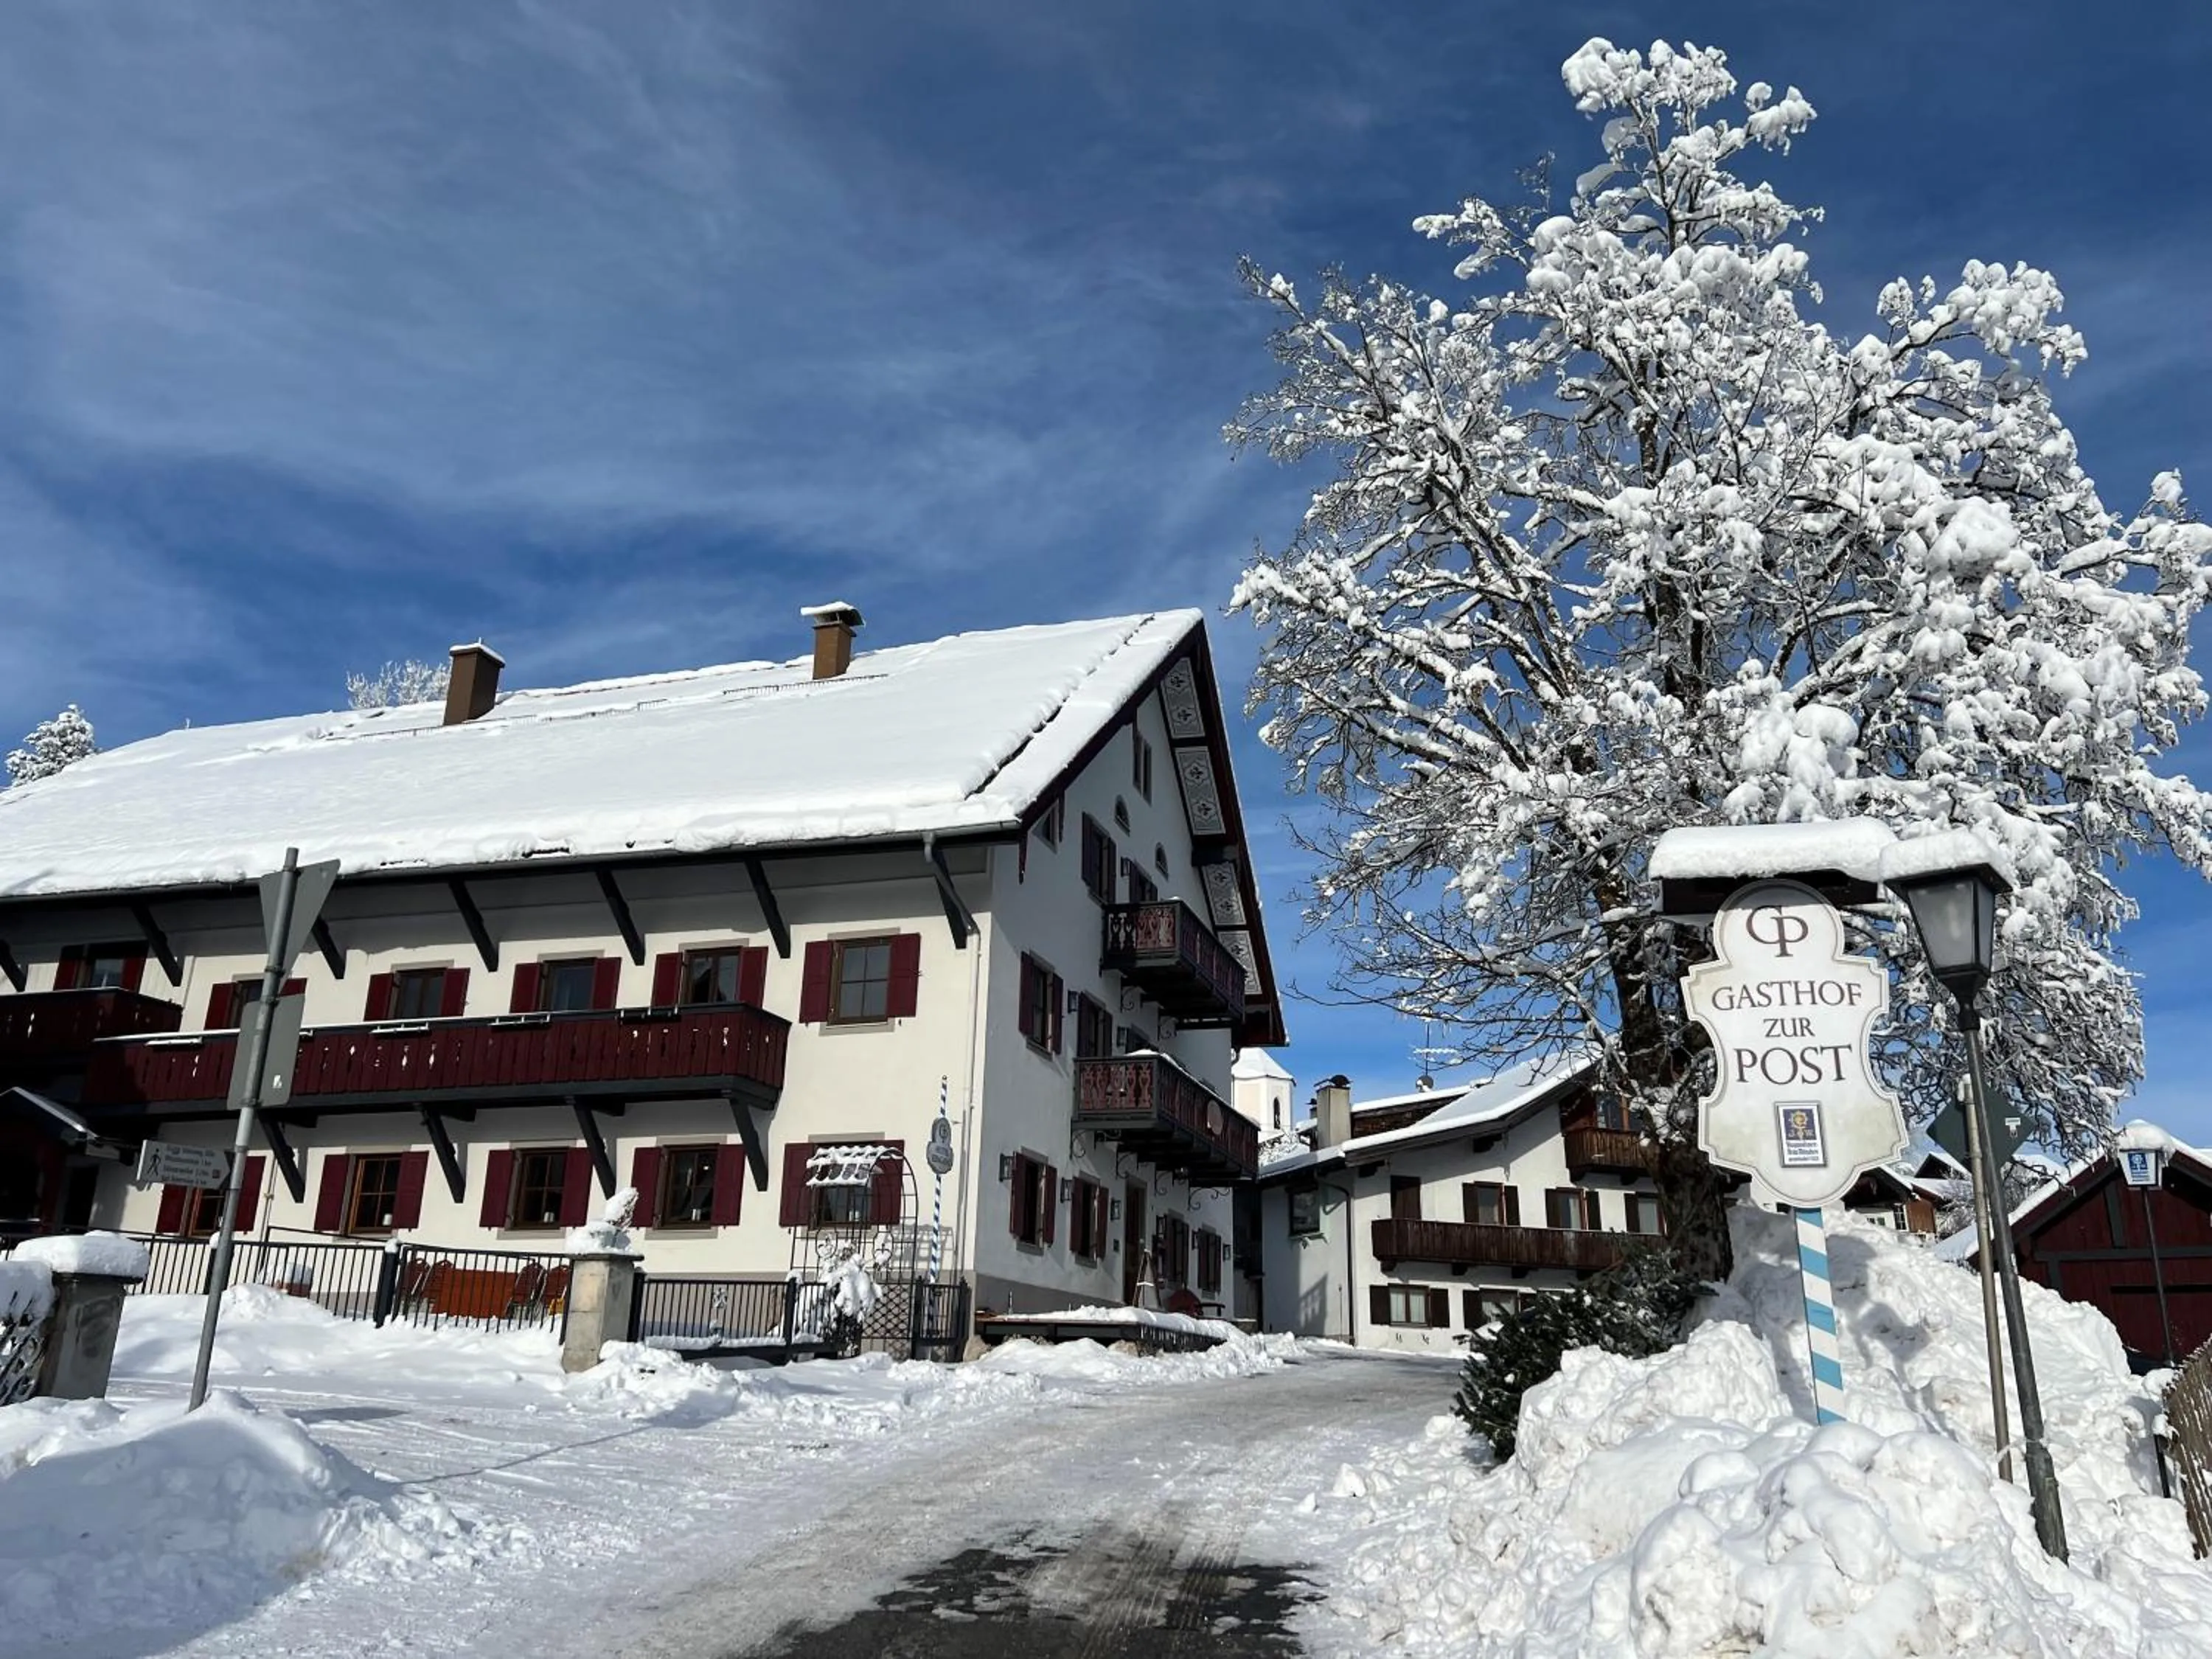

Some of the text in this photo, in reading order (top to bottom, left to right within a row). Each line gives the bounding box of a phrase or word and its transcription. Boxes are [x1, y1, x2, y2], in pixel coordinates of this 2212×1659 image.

[1711, 980, 1862, 1011] GASTHOF
[1763, 1018, 1815, 1037] ZUR
[1734, 1044, 1852, 1085] POST
